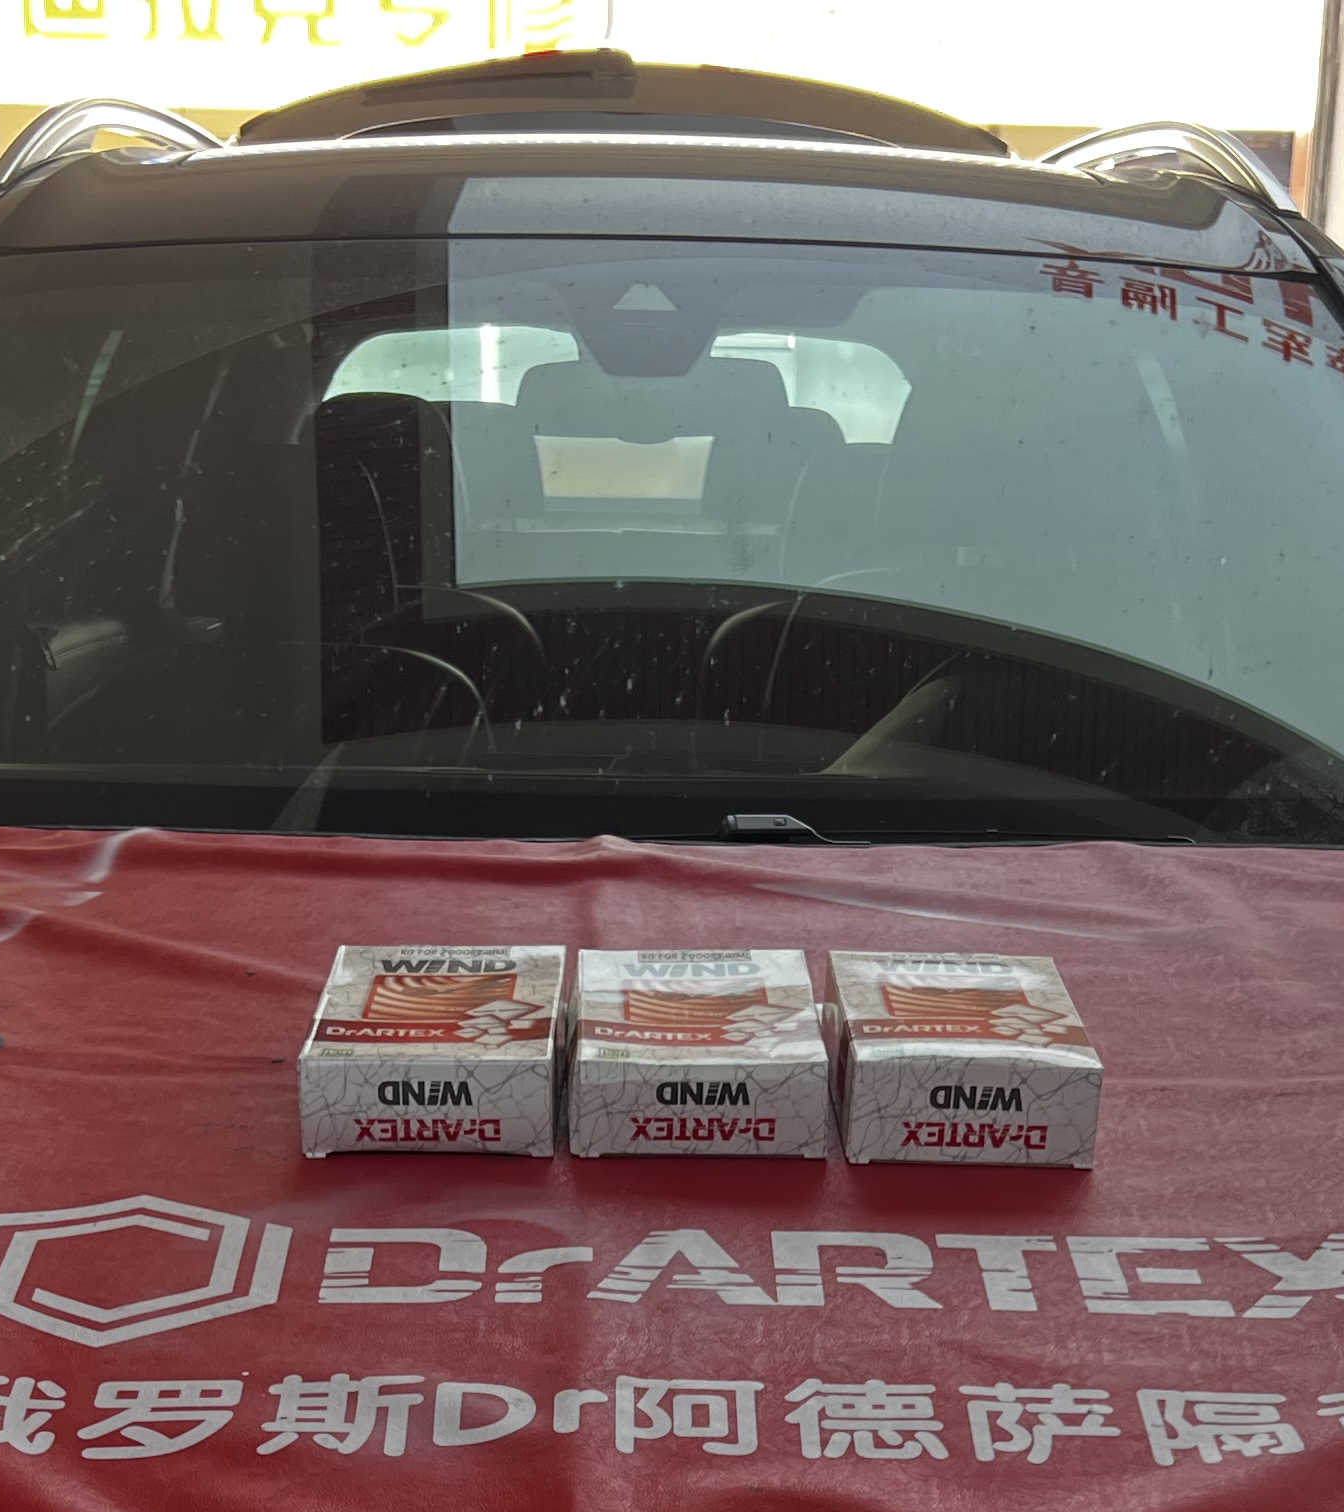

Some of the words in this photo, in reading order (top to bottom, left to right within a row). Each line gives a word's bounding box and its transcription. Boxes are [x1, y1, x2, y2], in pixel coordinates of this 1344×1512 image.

[381, 960, 518, 973] WIND
[622, 963, 761, 977] WIND
[326, 1026, 446, 1038] DrARTEX
[594, 1026, 712, 1041] DrARTEX
[862, 1024, 984, 1034] DrARTEX
[377, 1081, 473, 1106] WIND
[656, 1082, 750, 1106] WIND
[929, 1085, 1023, 1112] WIND
[353, 1119, 501, 1142] DrARTEX
[629, 1117, 776, 1142] DrARTEX
[901, 1121, 1049, 1150] DrARTEX
